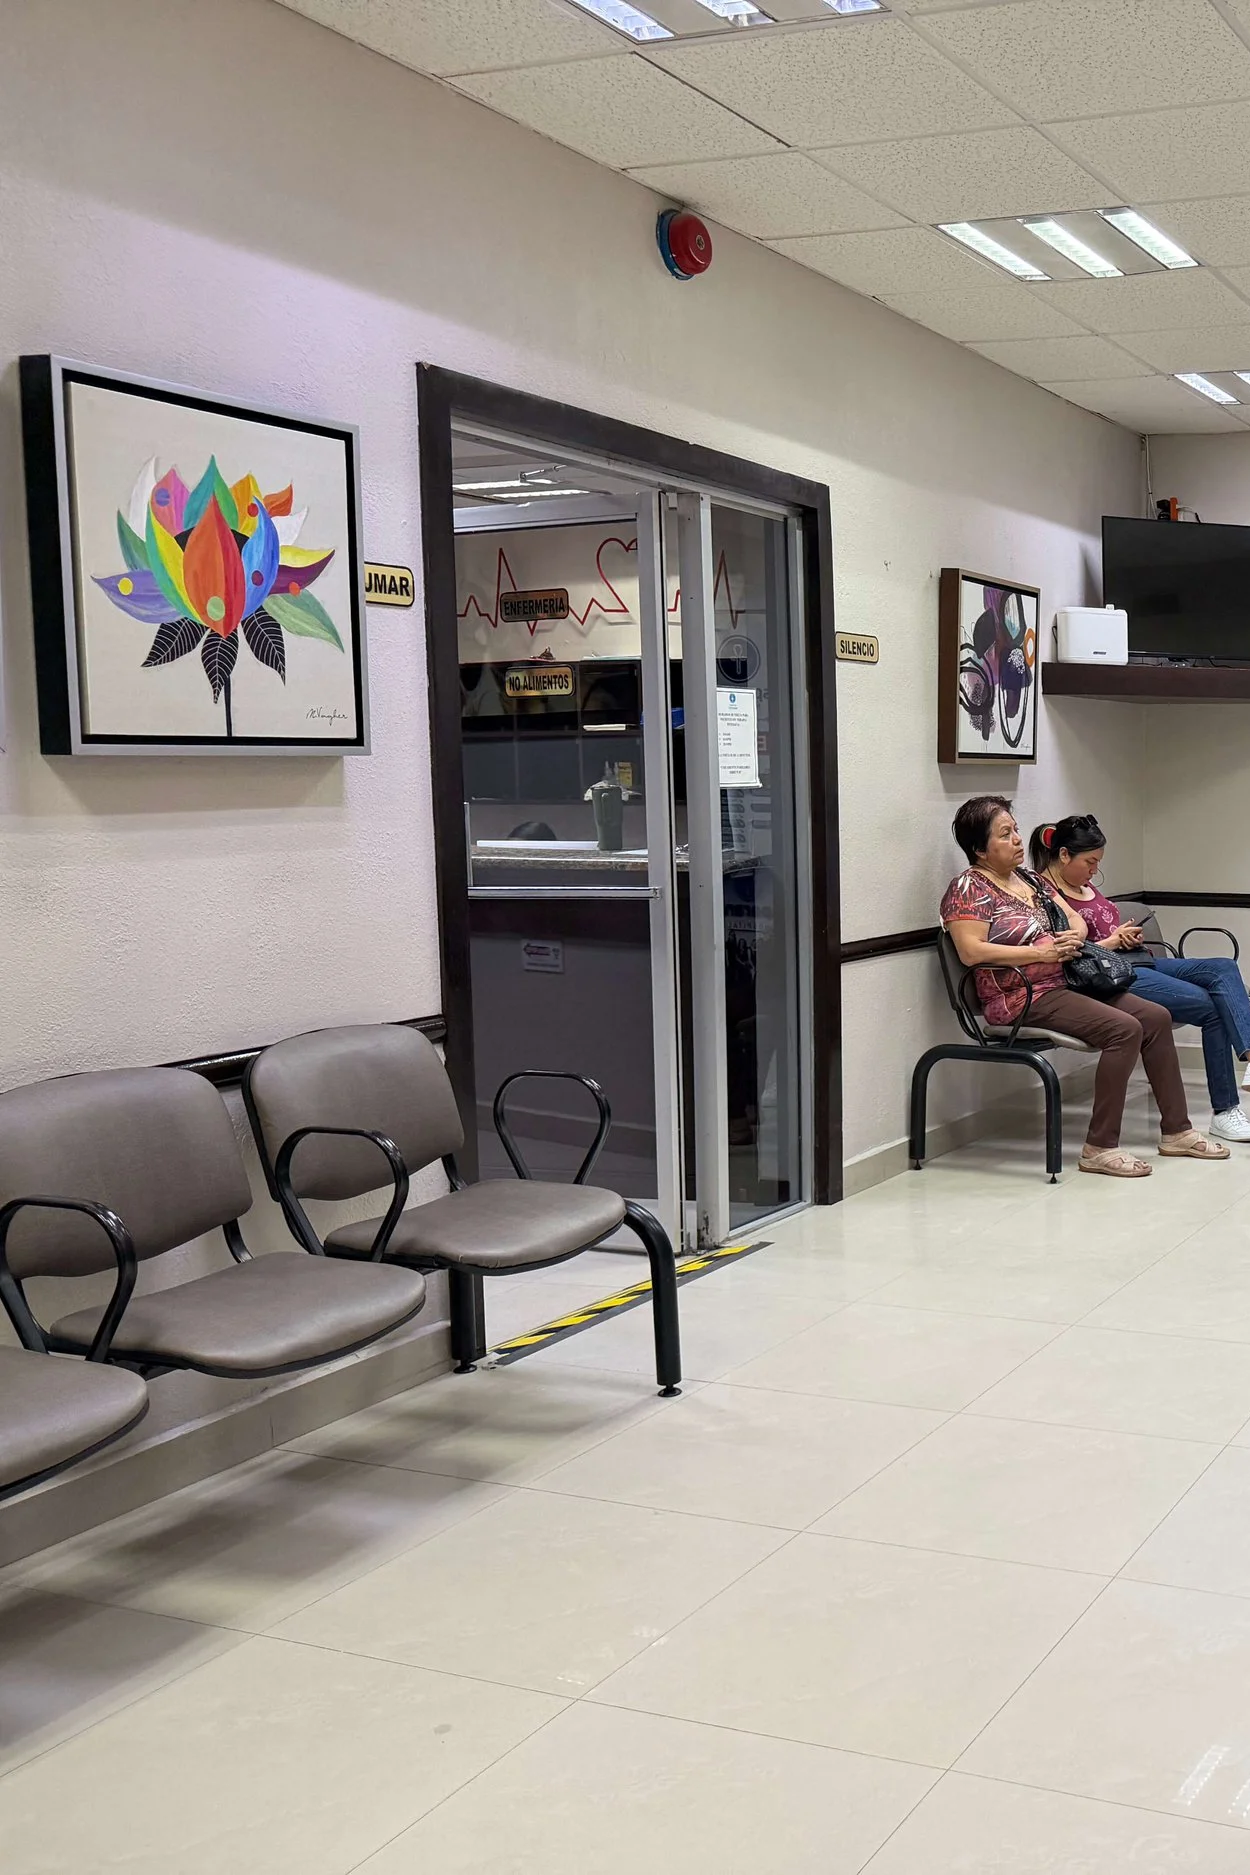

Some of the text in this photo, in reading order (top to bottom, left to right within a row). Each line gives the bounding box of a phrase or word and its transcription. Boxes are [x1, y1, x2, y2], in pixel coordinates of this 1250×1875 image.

[840, 640, 874, 657] SILENCIO
[509, 674, 569, 692] NO ALIMENTOS
